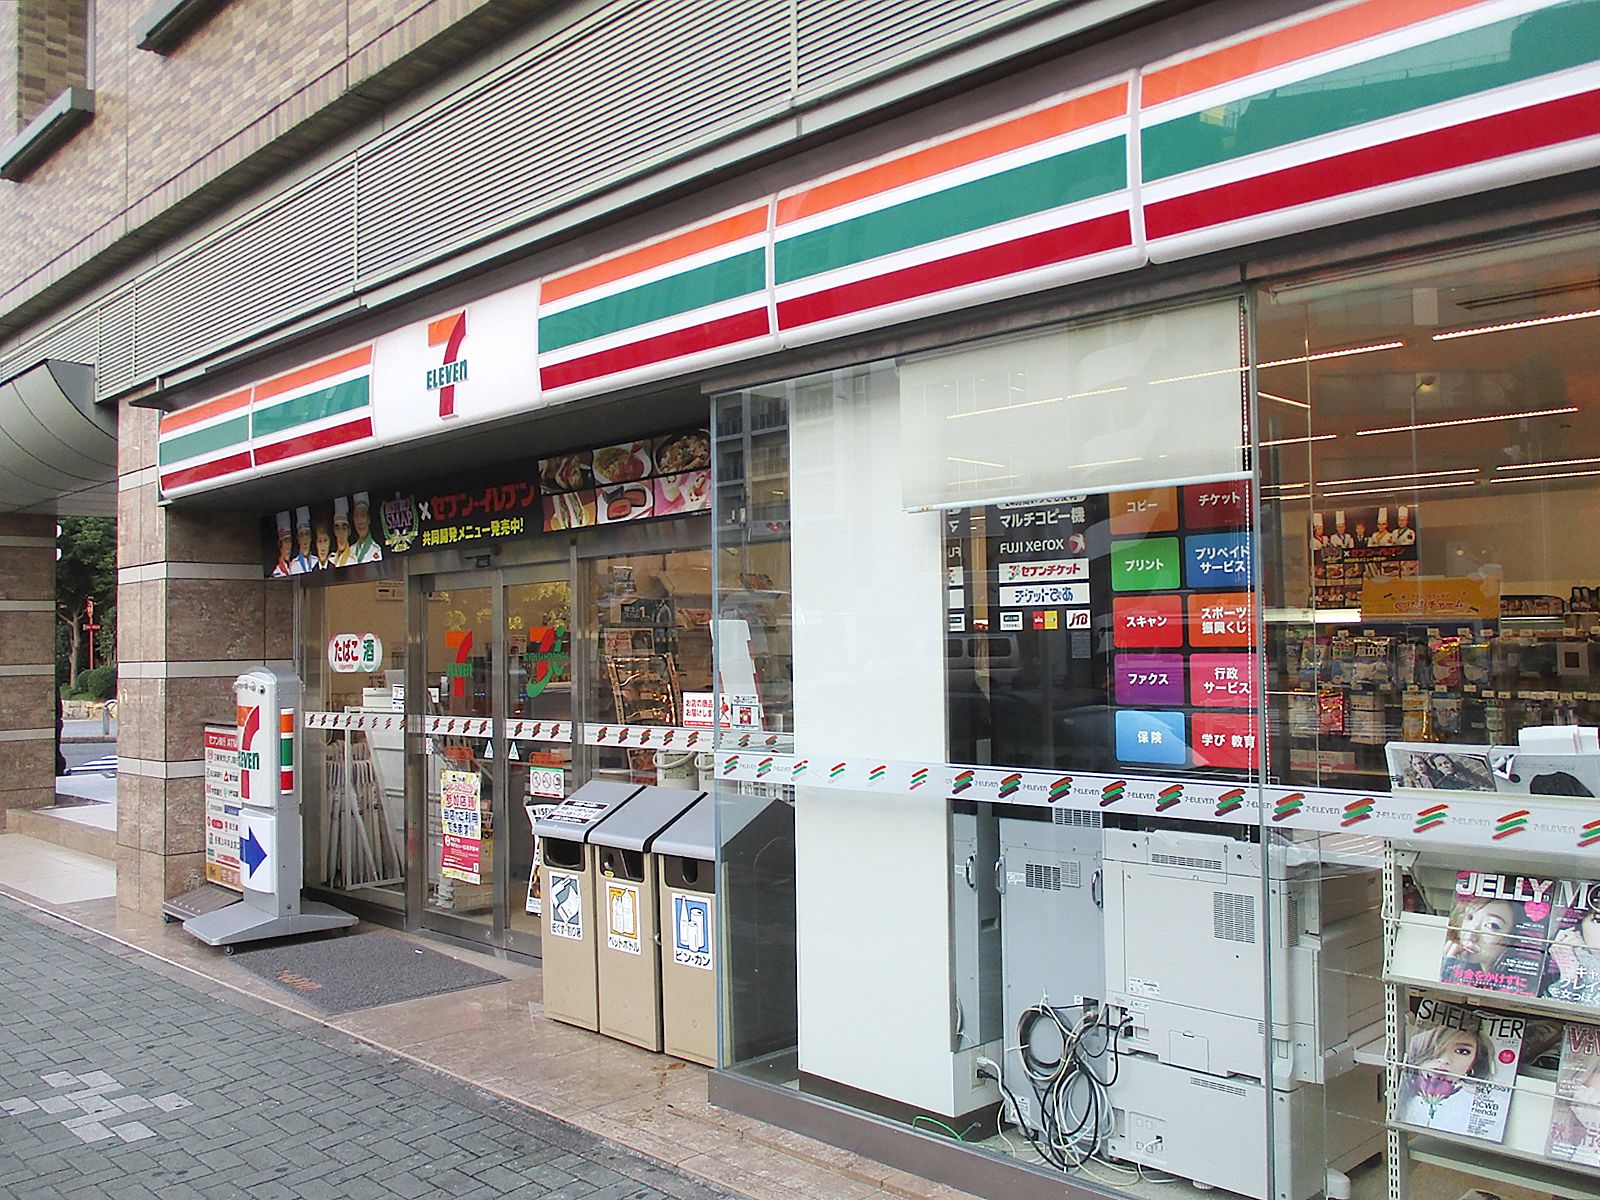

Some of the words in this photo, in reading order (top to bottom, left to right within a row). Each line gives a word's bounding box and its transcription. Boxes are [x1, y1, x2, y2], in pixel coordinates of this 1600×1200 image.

[1127, 500, 1158, 512] コピー
[1199, 491, 1241, 507] チケット
[1000, 507, 1086, 528] マルチコピー機
[1000, 541, 1024, 554] FUJI
[1026, 538, 1065, 552] xerox
[1021, 563, 1081, 577] セブンチケット
[1125, 558, 1164, 571] プリント
[1200, 560, 1247, 574] サービス
[1015, 586, 1073, 603] チケットぴあ
[1201, 607, 1247, 620] スポーツ
[1126, 616, 1168, 628] スキャン
[1202, 621, 1247, 635] 振興くじ
[335, 639, 359, 662] たばこ
[363, 639, 374, 661] 酒
[1127, 672, 1169, 685] ファクス
[1214, 667, 1238, 680] 行政
[1203, 681, 1251, 695] サービス
[1137, 731, 1163, 744] 保険
[1201, 733, 1226, 747] 学び
[1231, 735, 1256, 749] 教育
[1455, 872, 1553, 903] JELLY
[675, 951, 710, 967] ビン・カン
